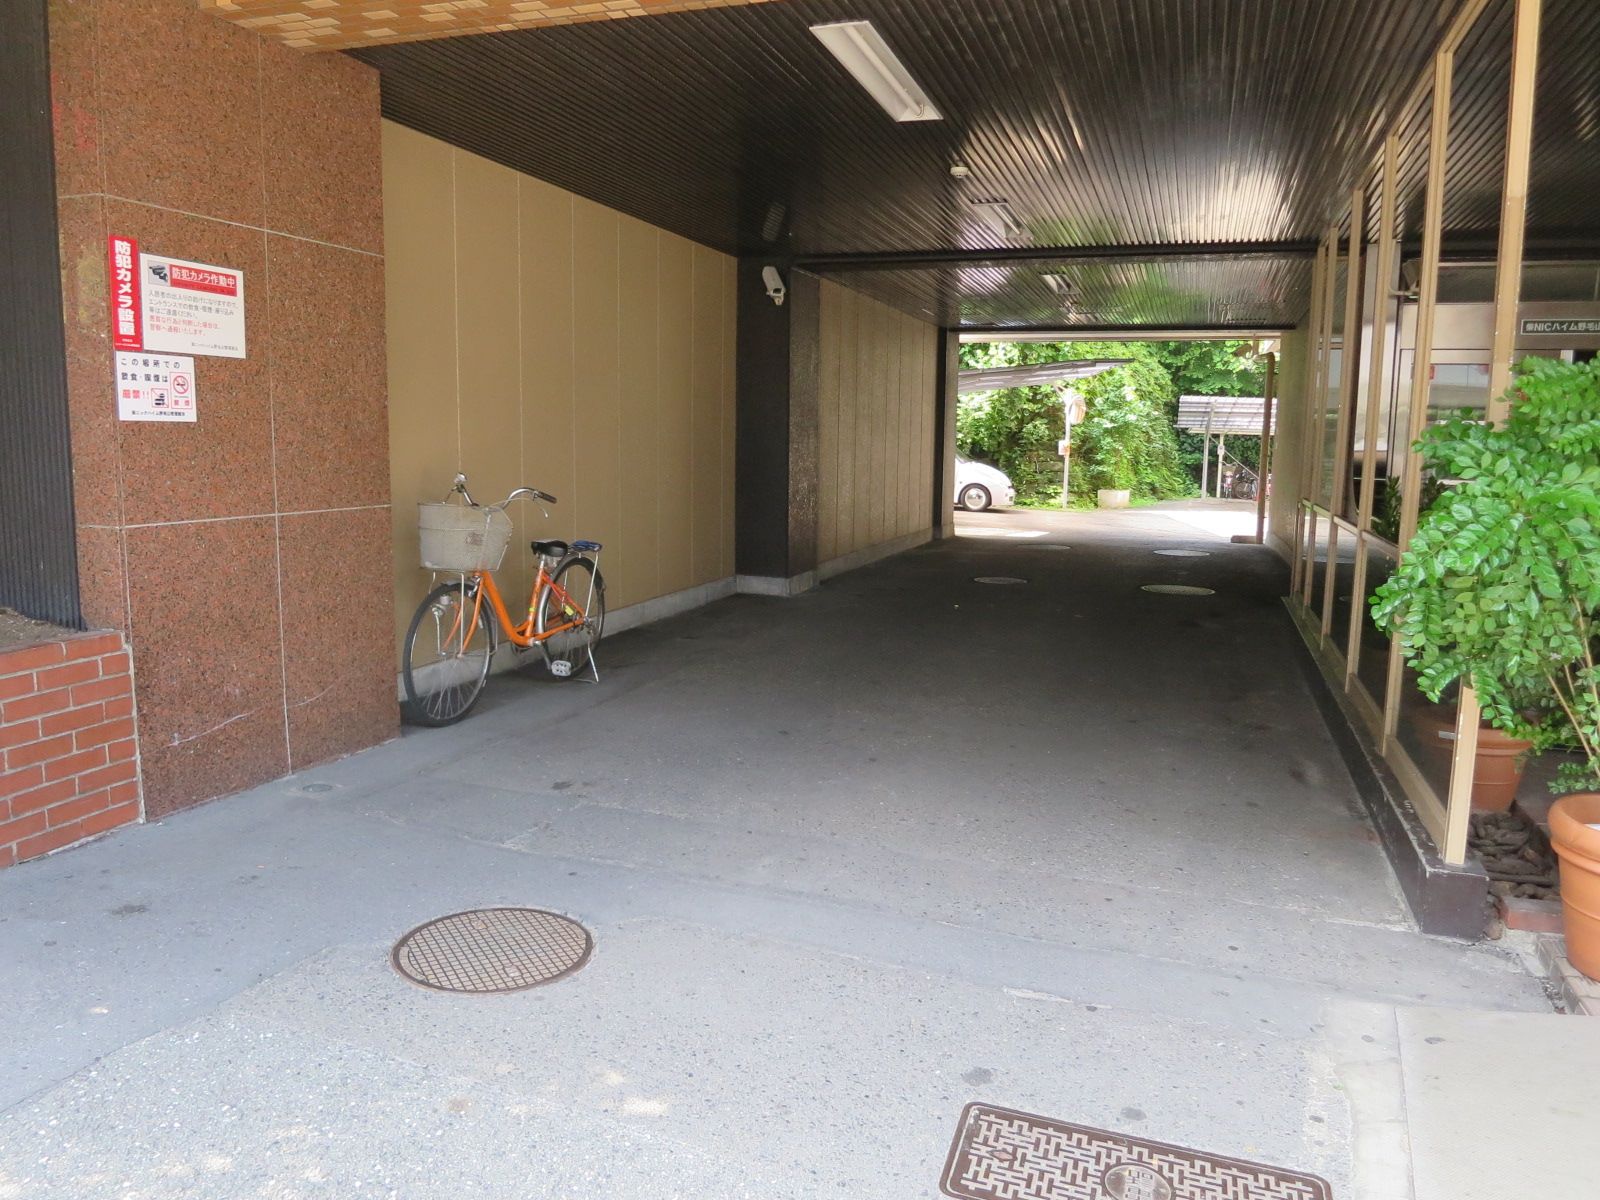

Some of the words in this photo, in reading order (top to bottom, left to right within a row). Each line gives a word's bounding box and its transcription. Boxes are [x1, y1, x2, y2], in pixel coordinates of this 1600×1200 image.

[171, 265, 236, 289] 防犯カメラ作動中
[114, 239, 136, 336] 防犯カメラ設置
[121, 358, 180, 369] この場所での
[121, 372, 168, 383] 飲食・喫煙は
